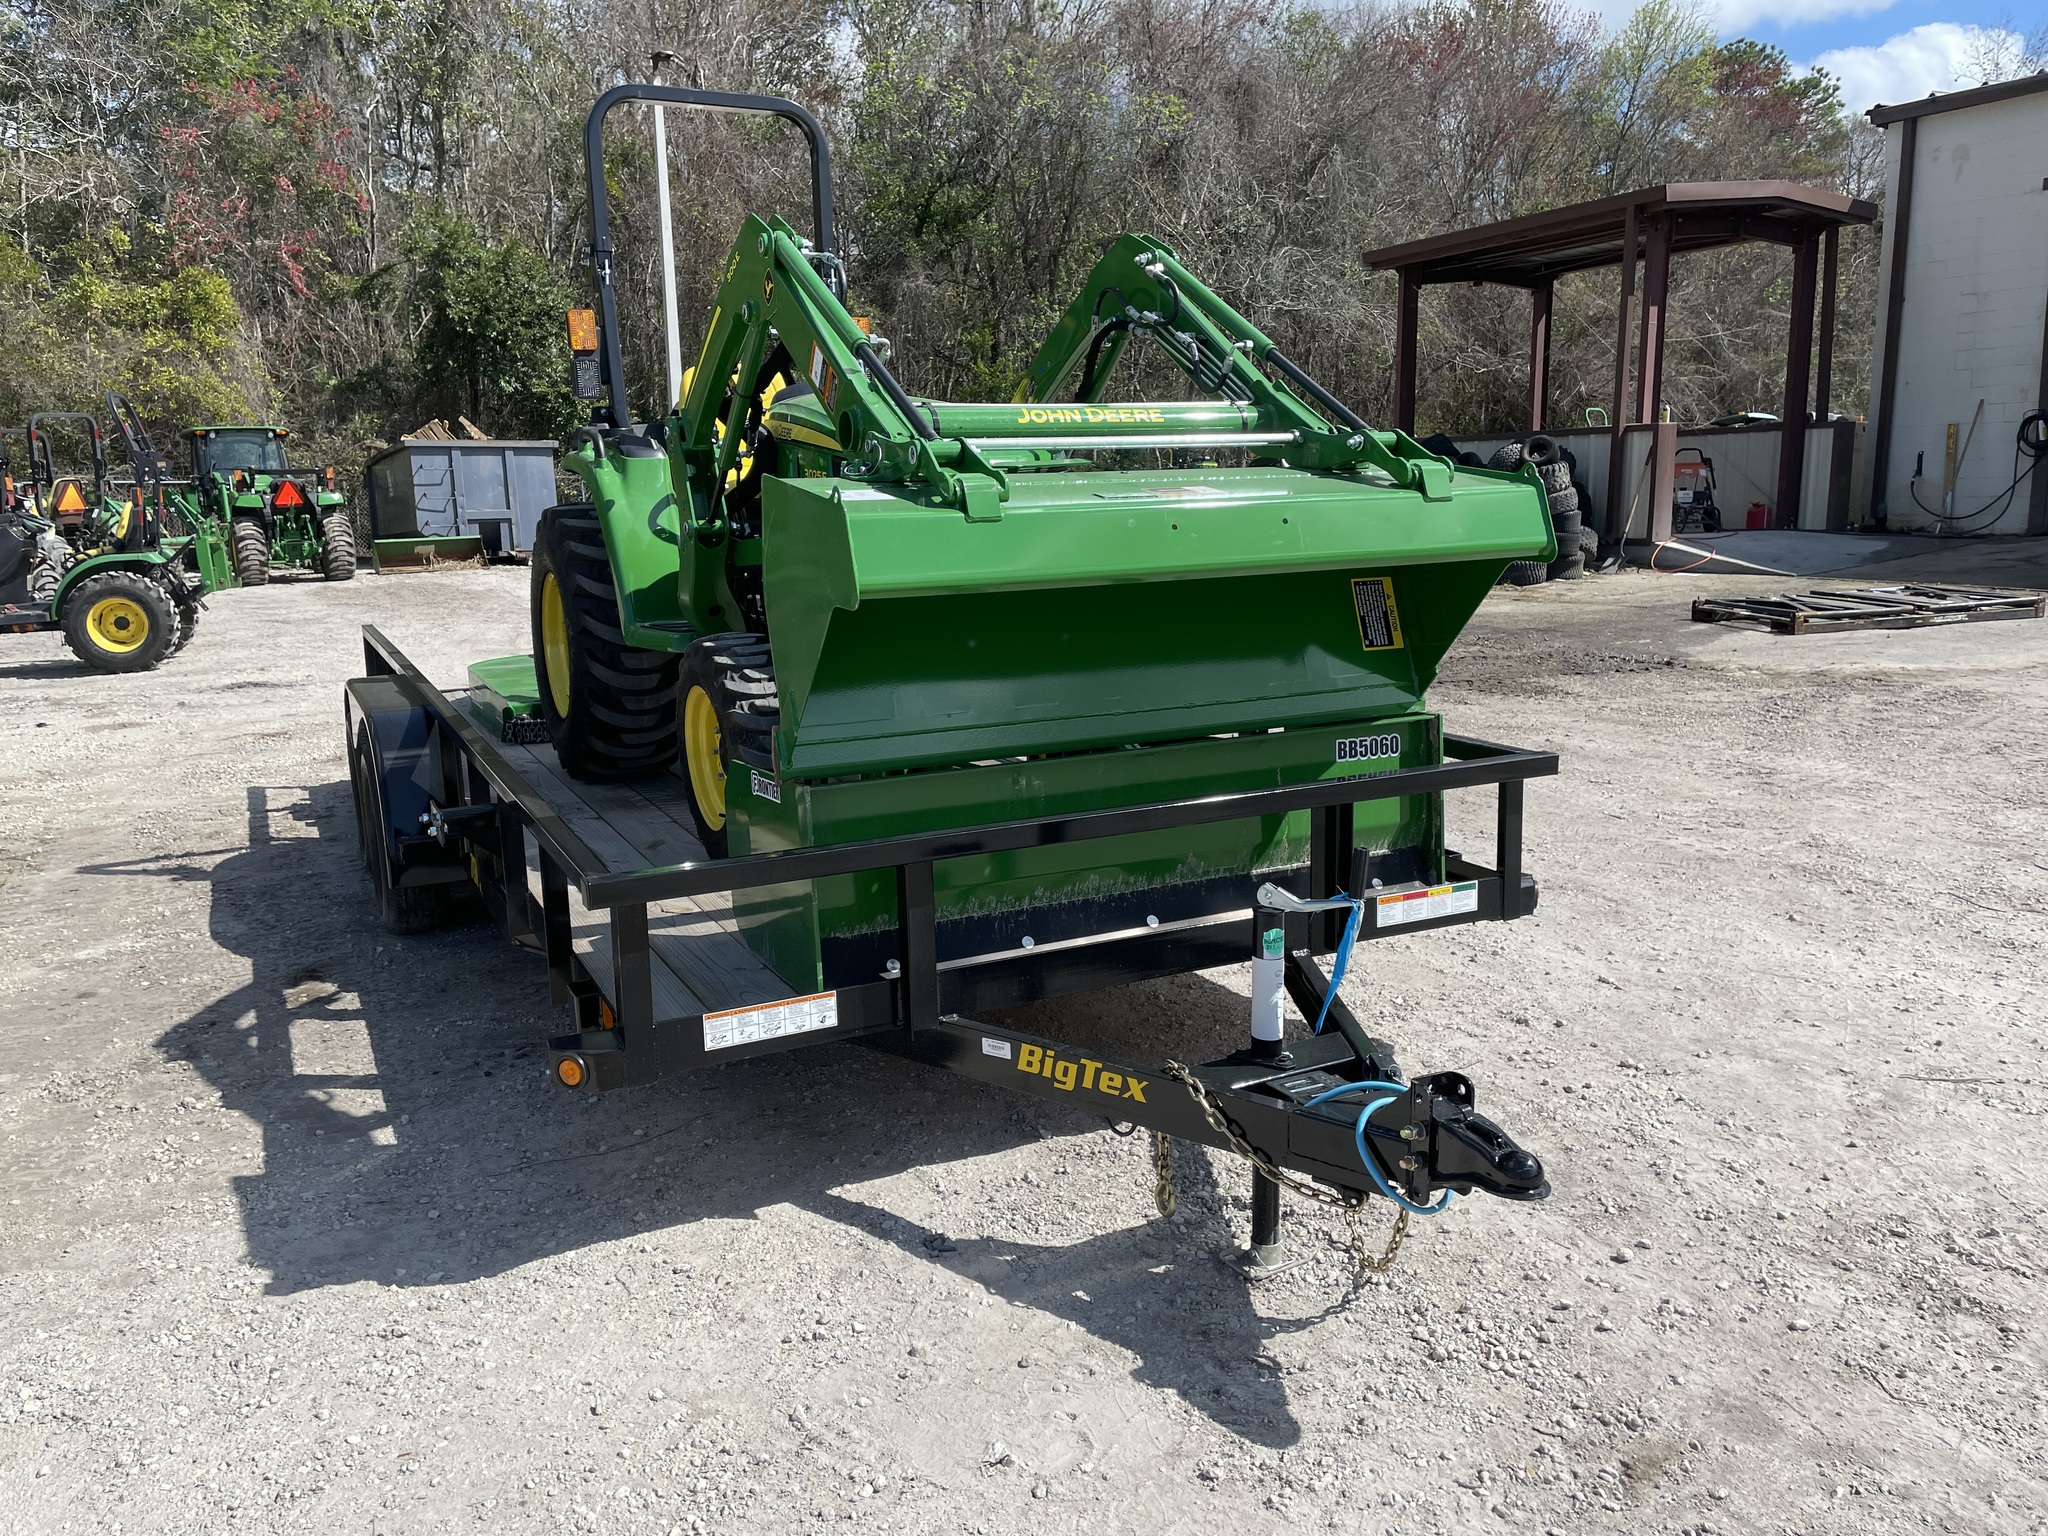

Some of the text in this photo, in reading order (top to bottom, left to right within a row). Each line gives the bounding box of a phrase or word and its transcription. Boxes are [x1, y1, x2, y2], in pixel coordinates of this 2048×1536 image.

[1017, 408, 1165, 424] JOHN DEERE
[1388, 604, 1399, 632] CAUTION
[1337, 734, 1400, 761] BB5060
[1017, 1043, 1149, 1103] BigTex
